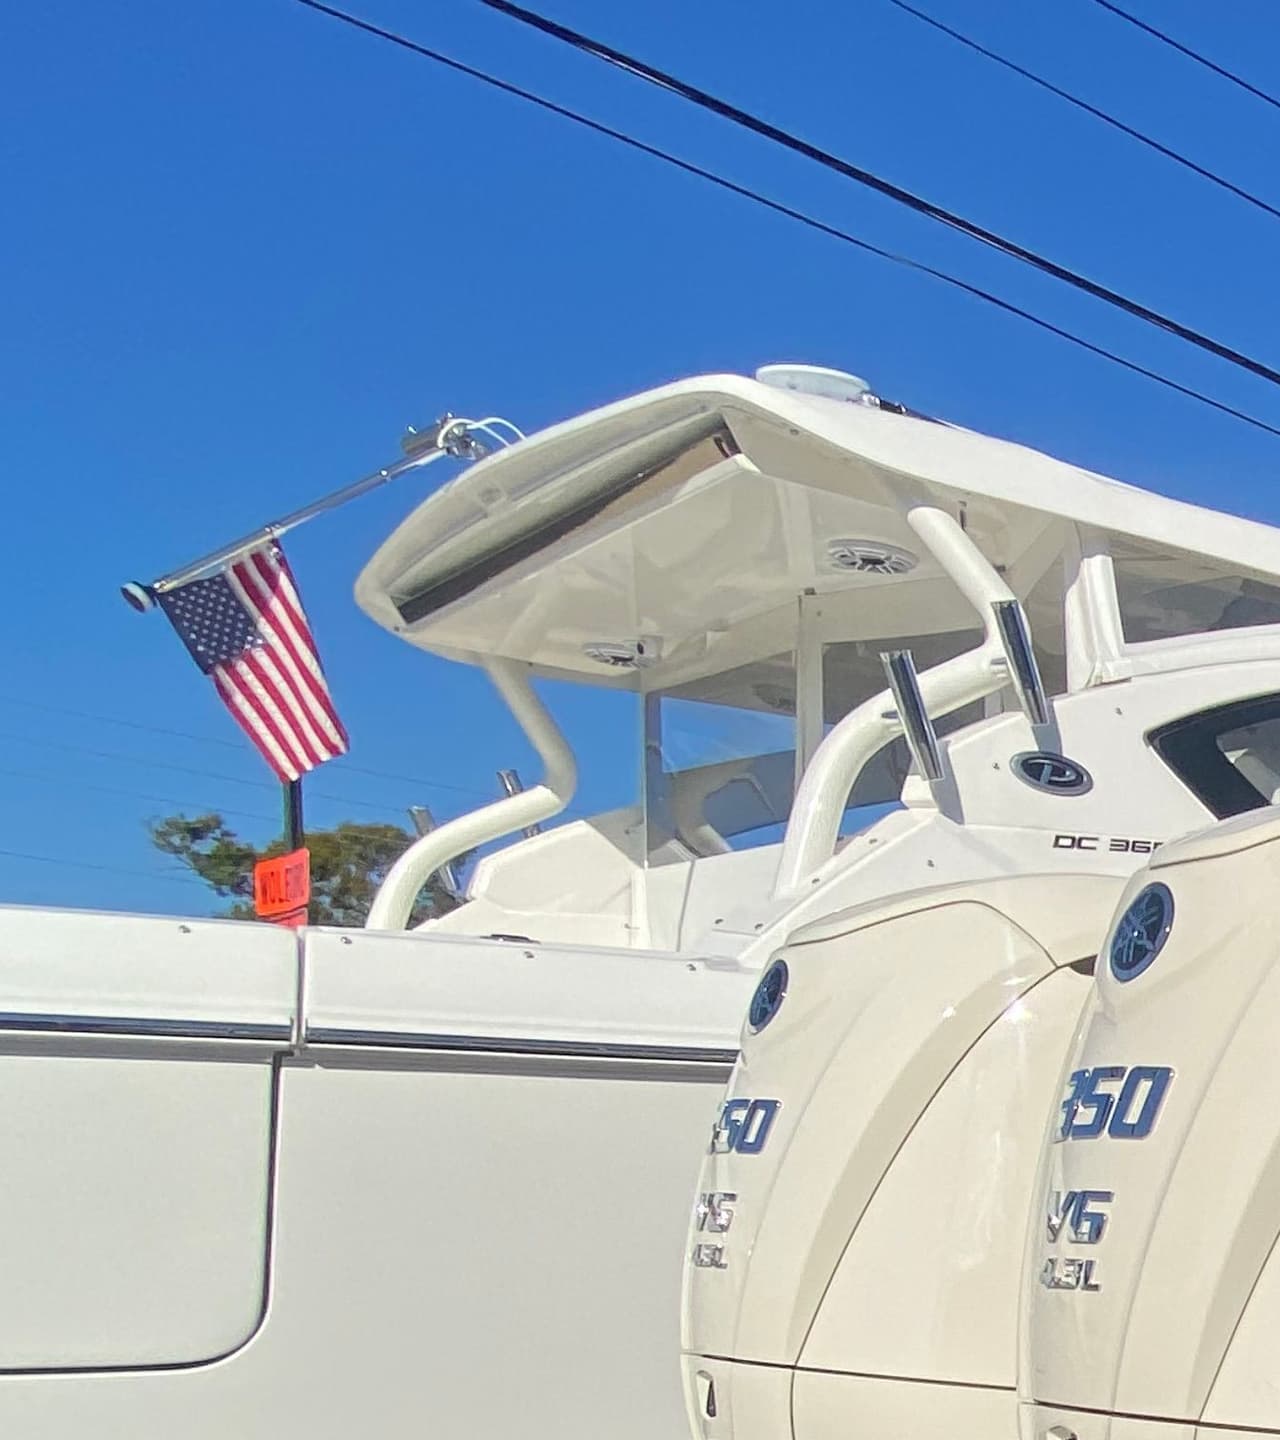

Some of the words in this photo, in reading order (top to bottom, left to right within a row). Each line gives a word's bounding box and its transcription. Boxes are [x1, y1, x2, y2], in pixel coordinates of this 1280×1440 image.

[1052, 835, 1100, 850] DC
[709, 1098, 783, 1154] 50
[1054, 1066, 1176, 1143] 350
[1047, 1191, 1115, 1244] V6
